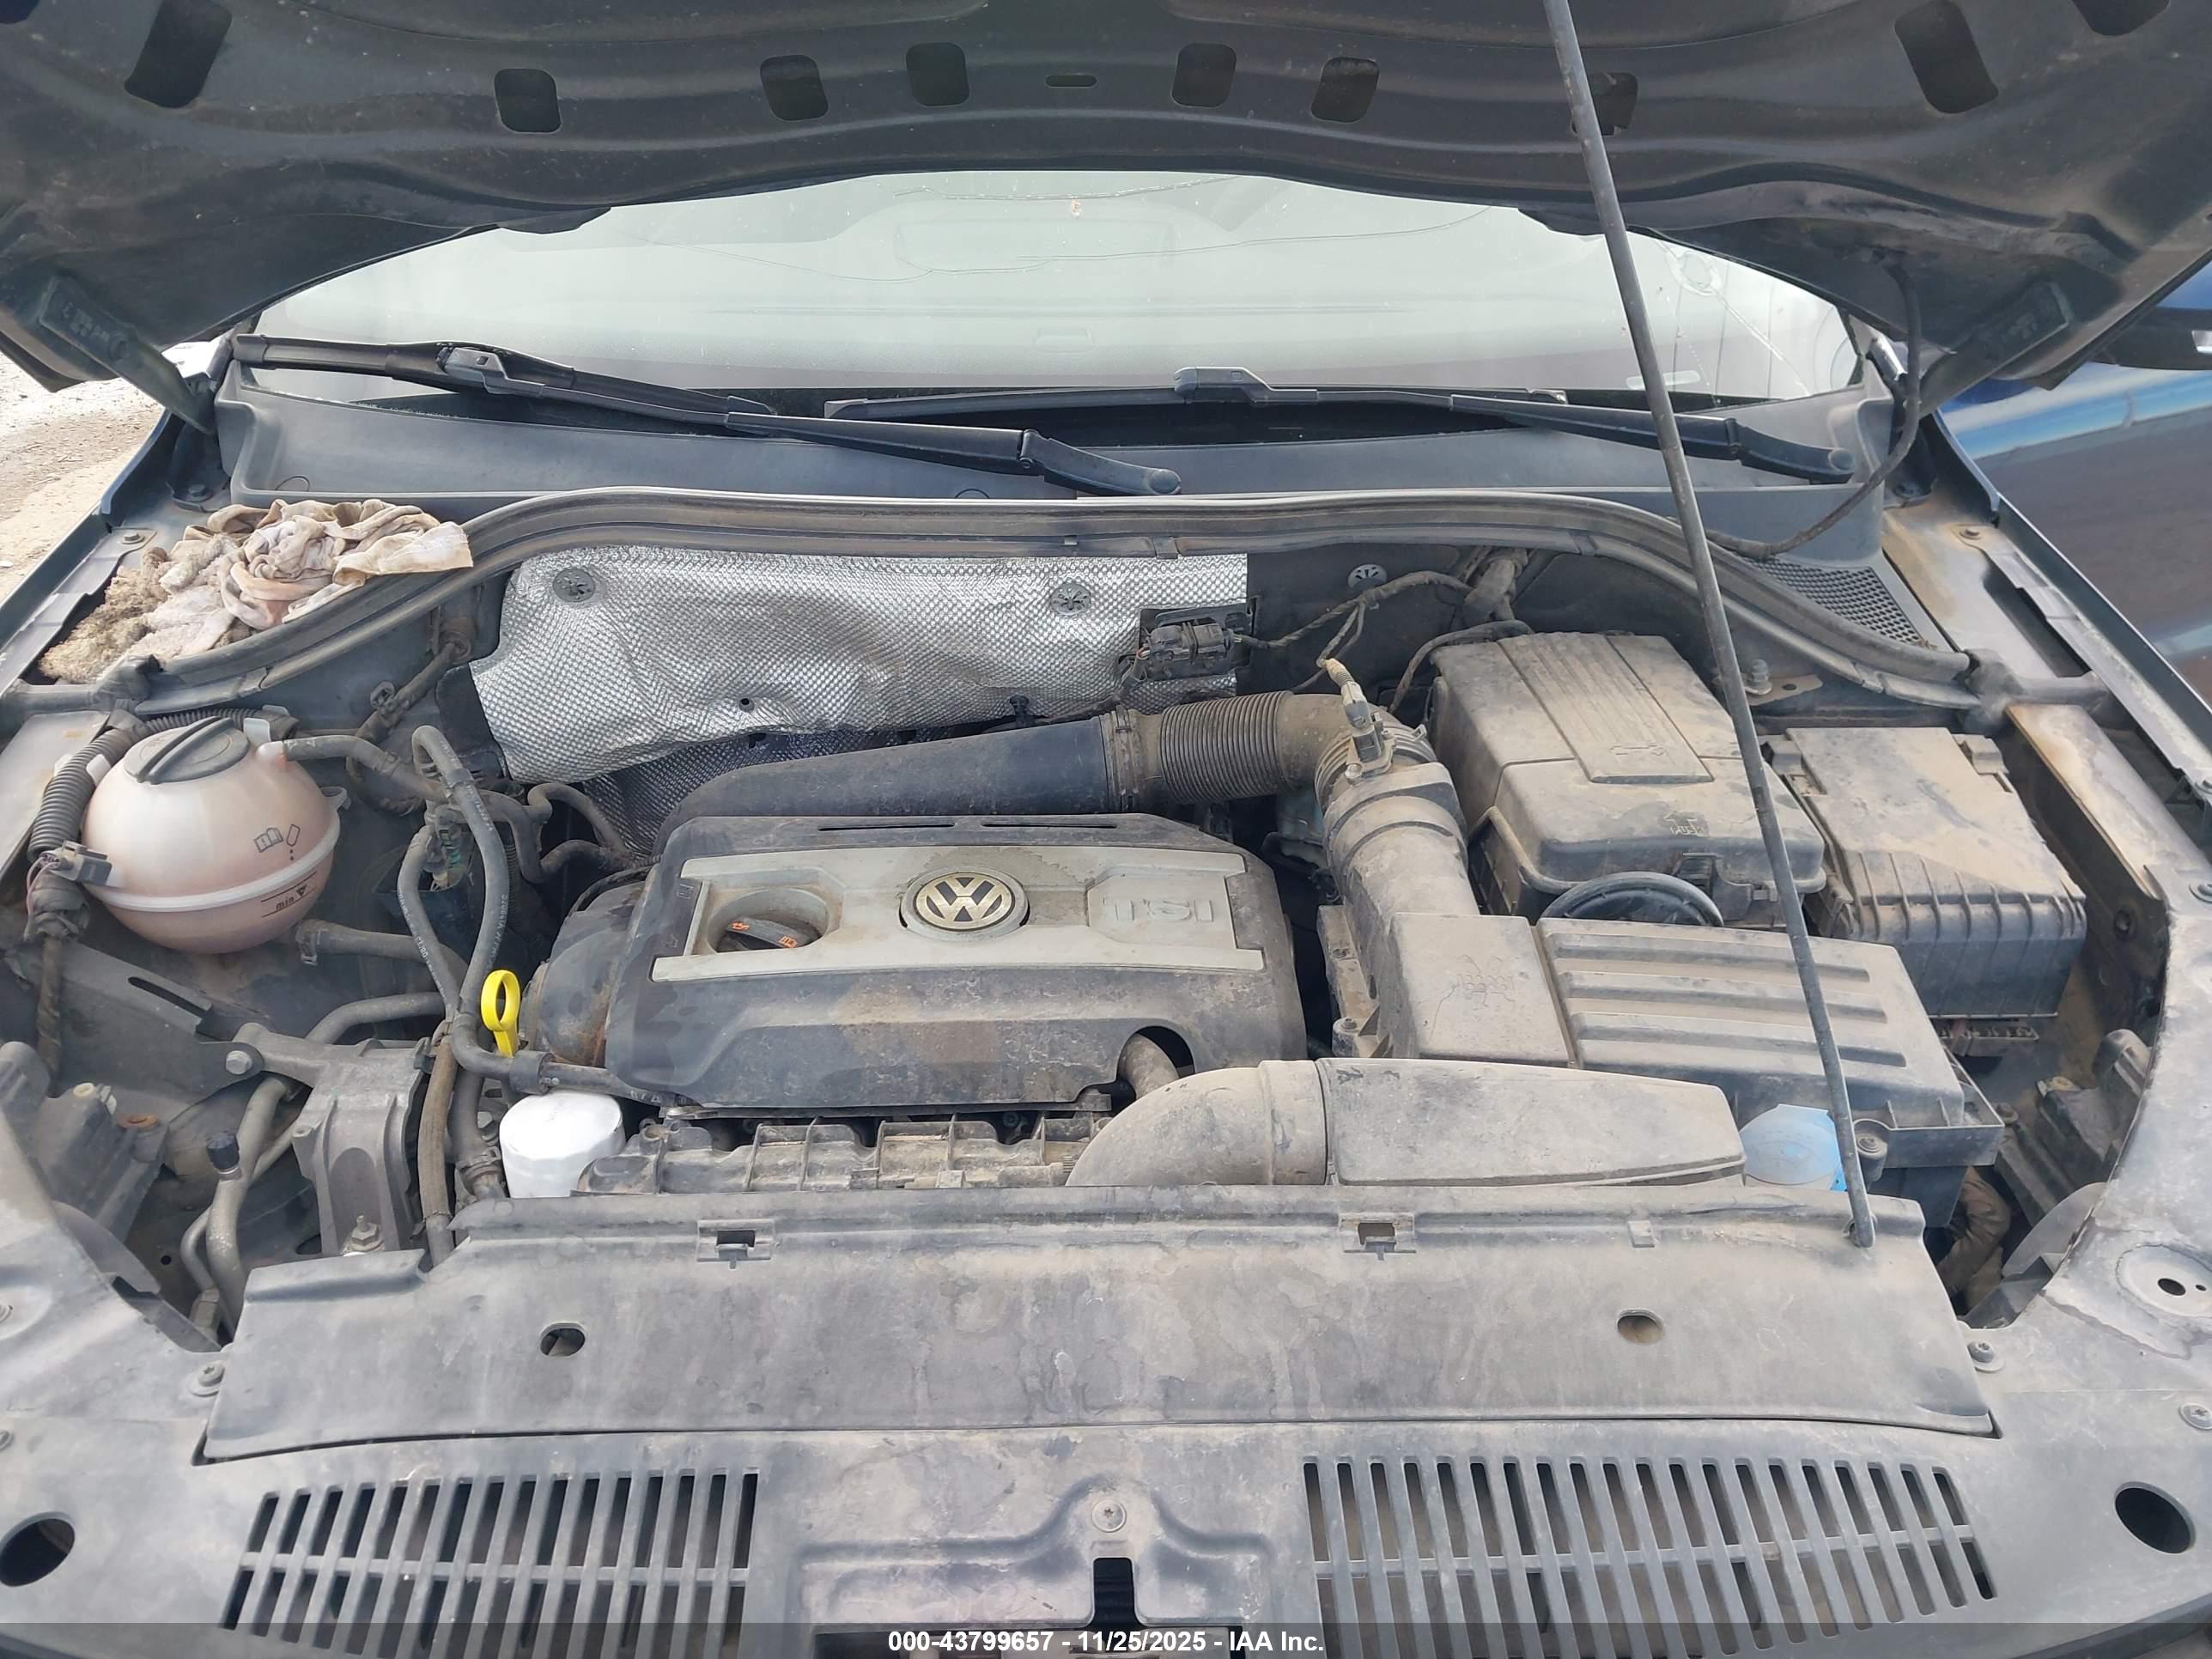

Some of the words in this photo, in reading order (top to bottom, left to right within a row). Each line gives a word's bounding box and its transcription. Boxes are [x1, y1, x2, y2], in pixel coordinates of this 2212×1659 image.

[275, 896, 295, 911] min
[914, 872, 1014, 932] VW
[1102, 896, 1214, 923] TSI
